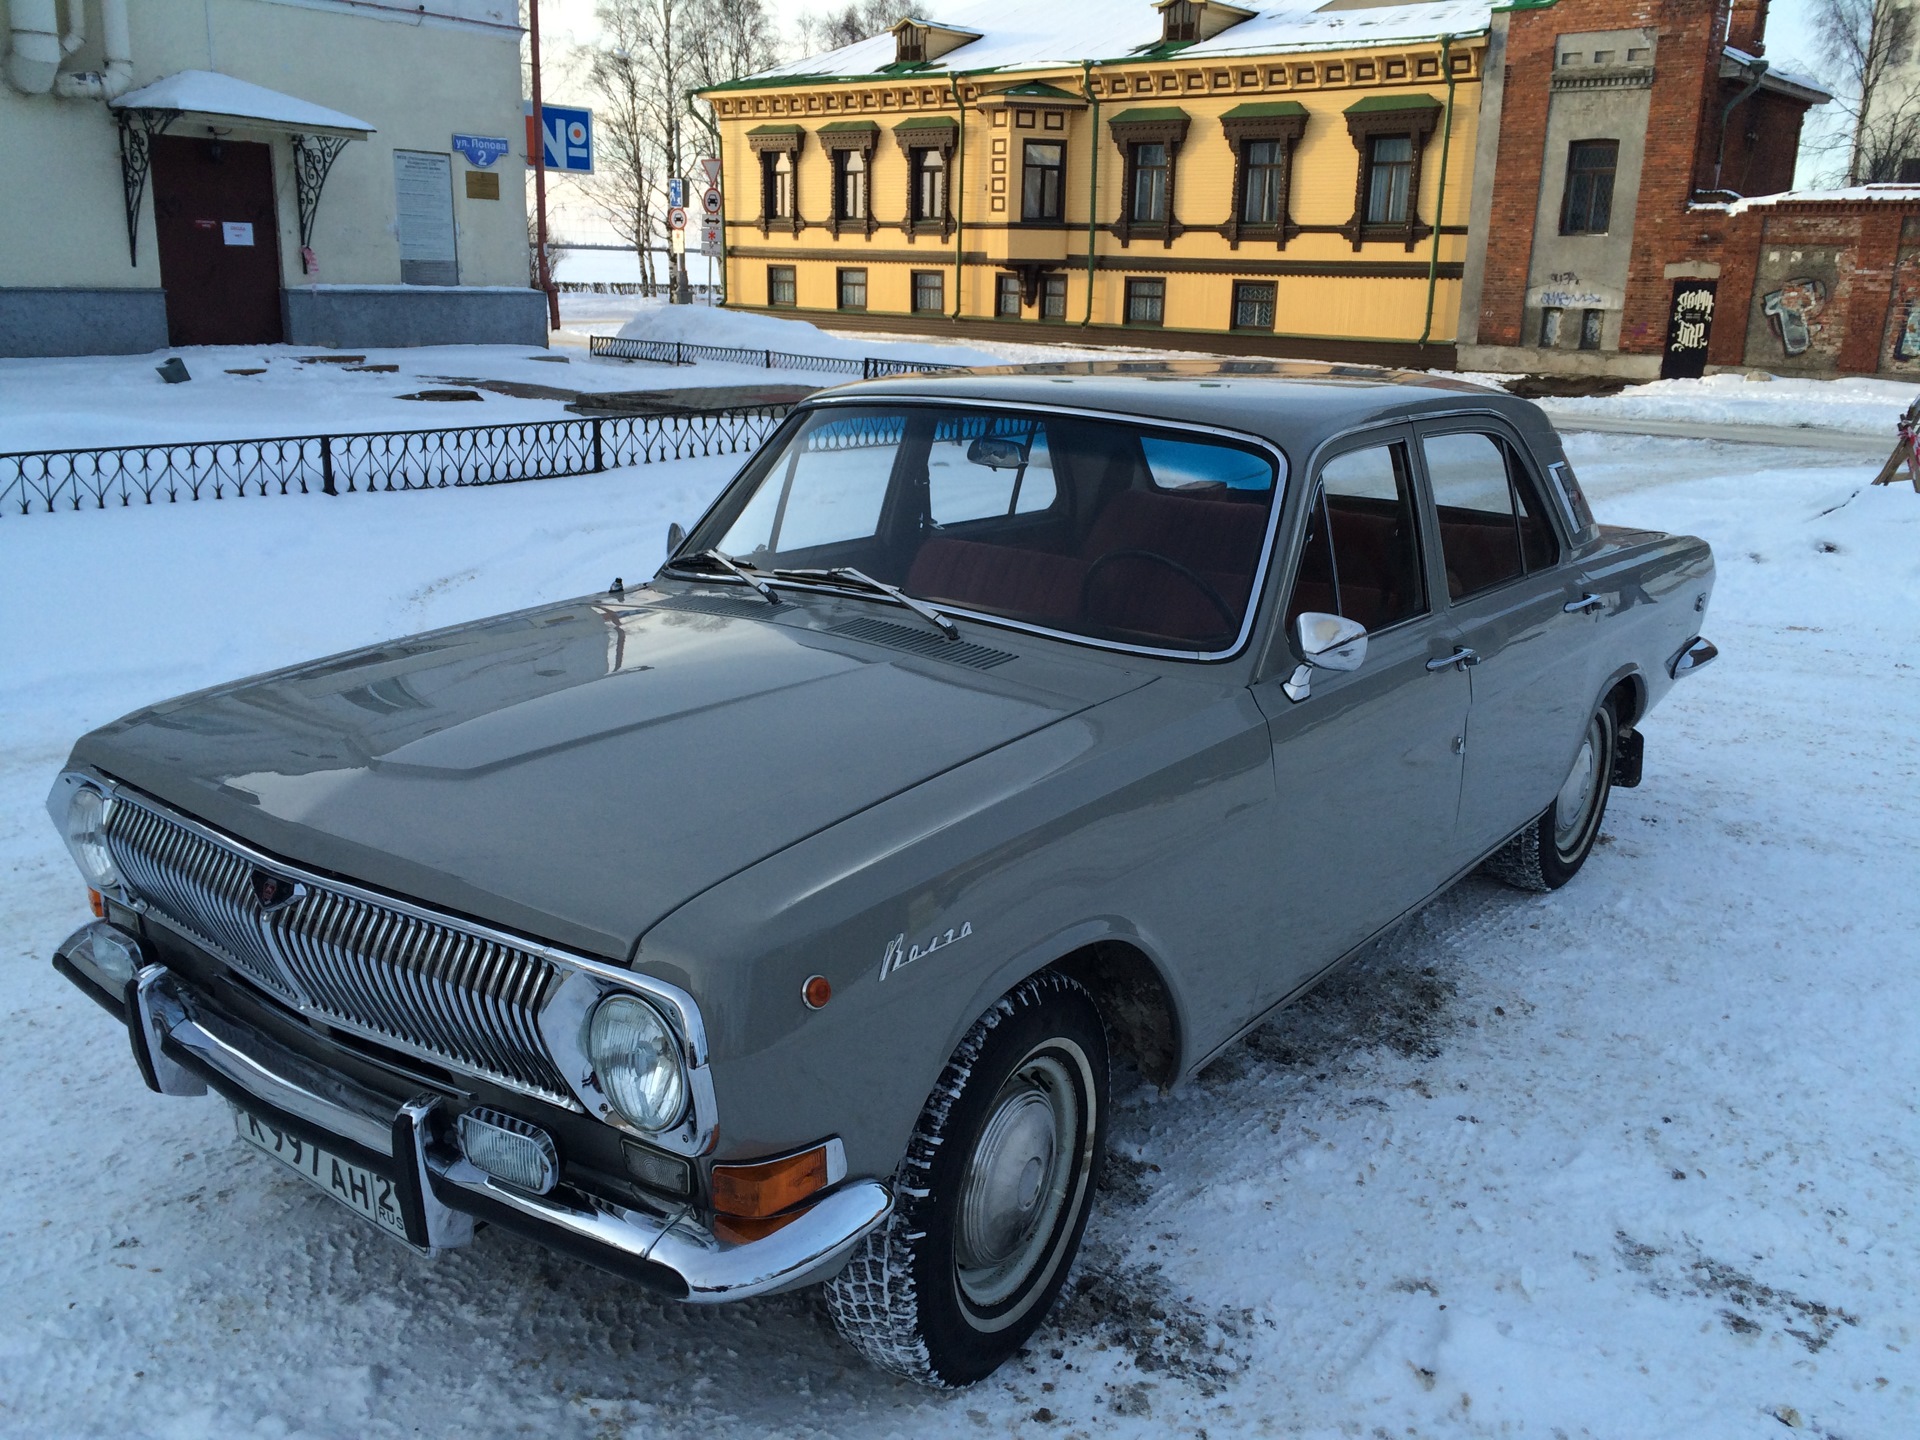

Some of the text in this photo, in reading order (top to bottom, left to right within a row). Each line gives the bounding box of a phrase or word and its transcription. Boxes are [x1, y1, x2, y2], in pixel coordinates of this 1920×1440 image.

[455, 139, 507, 150] ул. Попова
[477, 150, 487, 166] 2
[378, 1207, 404, 1231] RUS
